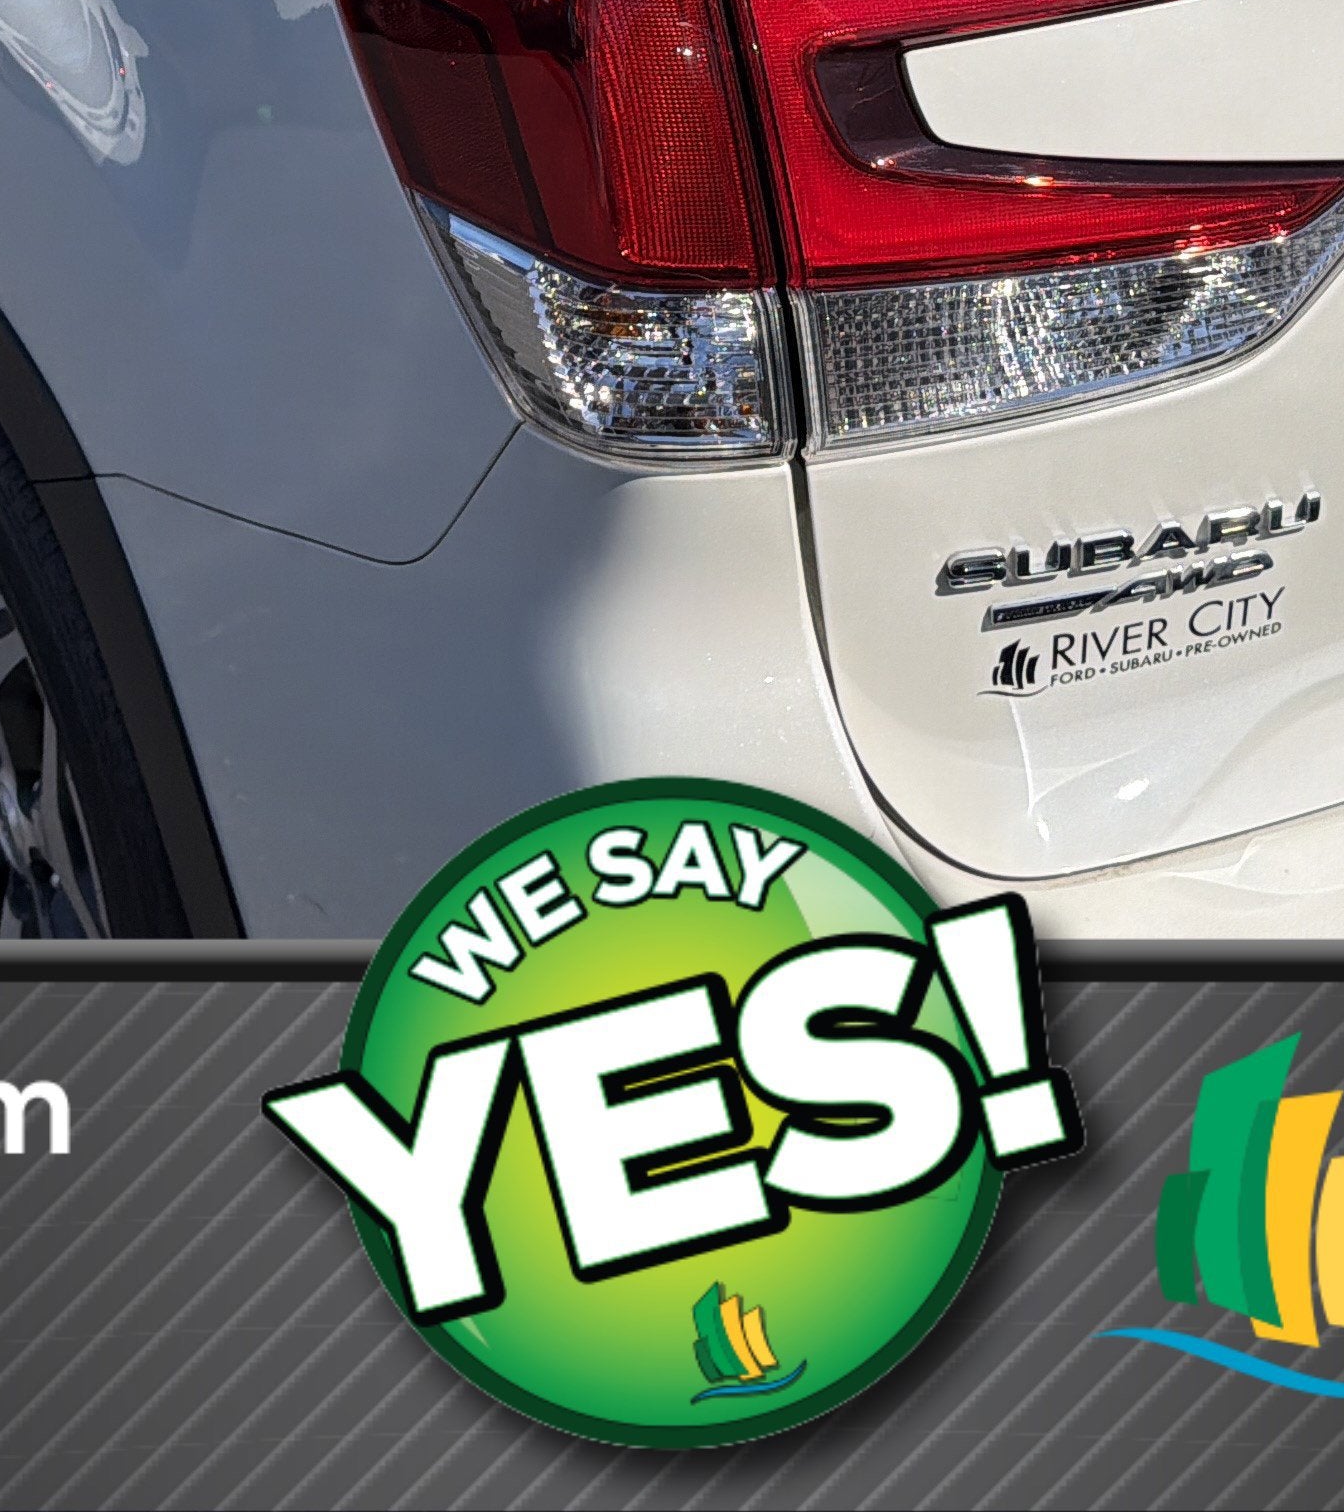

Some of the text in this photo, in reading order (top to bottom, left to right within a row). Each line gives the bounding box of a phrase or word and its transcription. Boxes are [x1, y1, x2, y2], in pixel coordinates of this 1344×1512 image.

[946, 491, 1321, 589] SUBARU
[1106, 548, 1274, 604] AWD
[1050, 621, 1282, 687] FORD SUBARU PRE-OWNED
[1051, 586, 1286, 670] RIVER CITY
